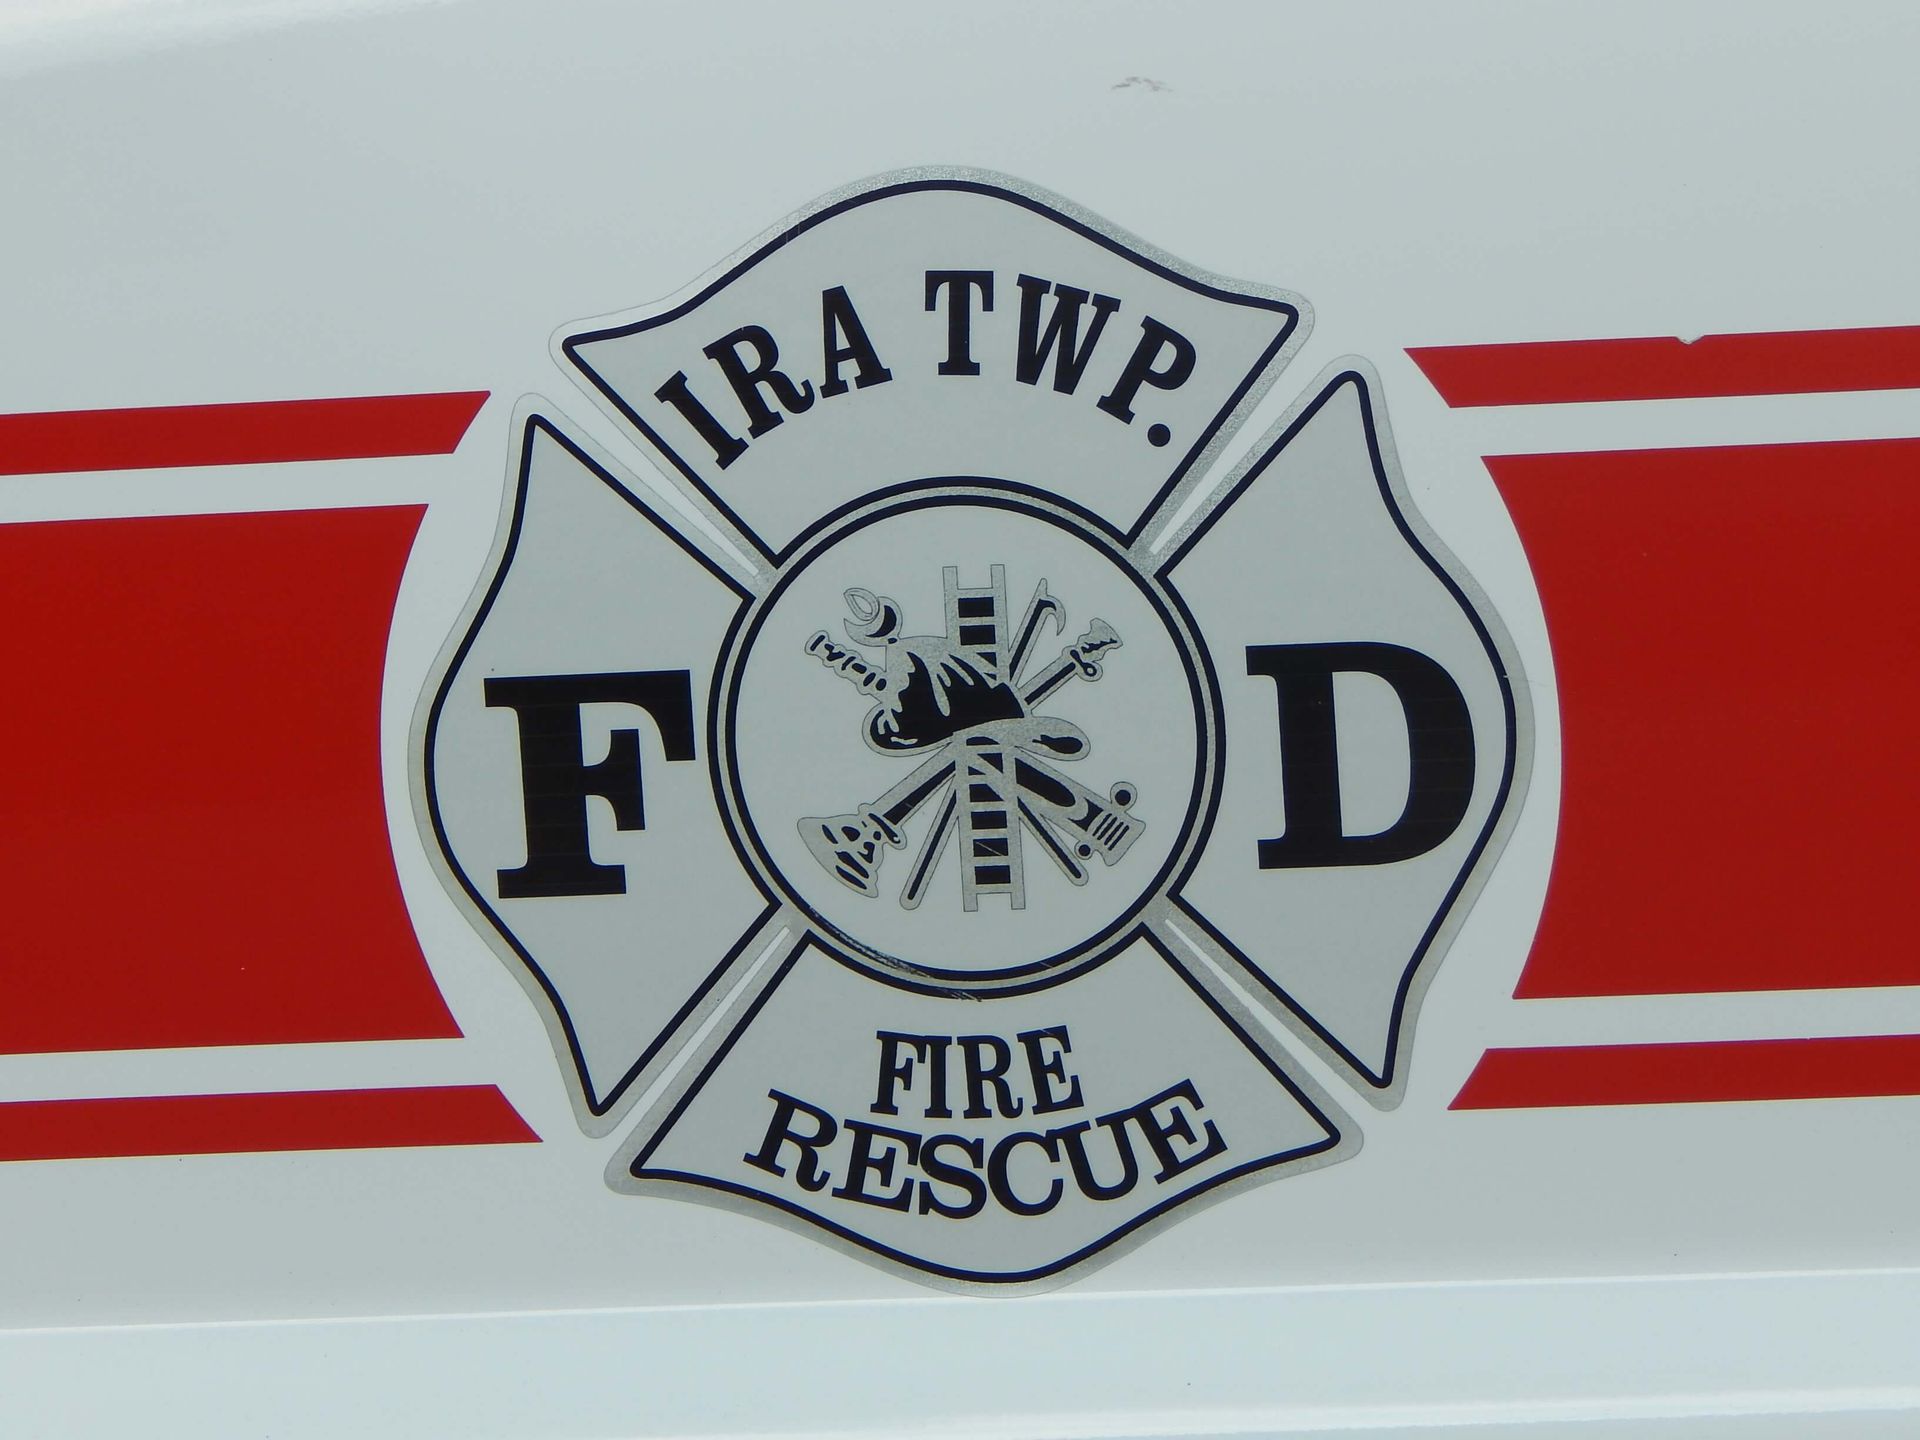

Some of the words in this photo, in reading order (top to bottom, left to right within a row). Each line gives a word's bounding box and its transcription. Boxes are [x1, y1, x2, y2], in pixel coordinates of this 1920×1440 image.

[654, 286, 893, 470] IRA
[925, 271, 1197, 448] TWP.
[484, 669, 696, 900] F
[1246, 641, 1476, 870] D
[743, 1079, 1228, 1219] RESCUE
[870, 1025, 1085, 1120] FIRE
